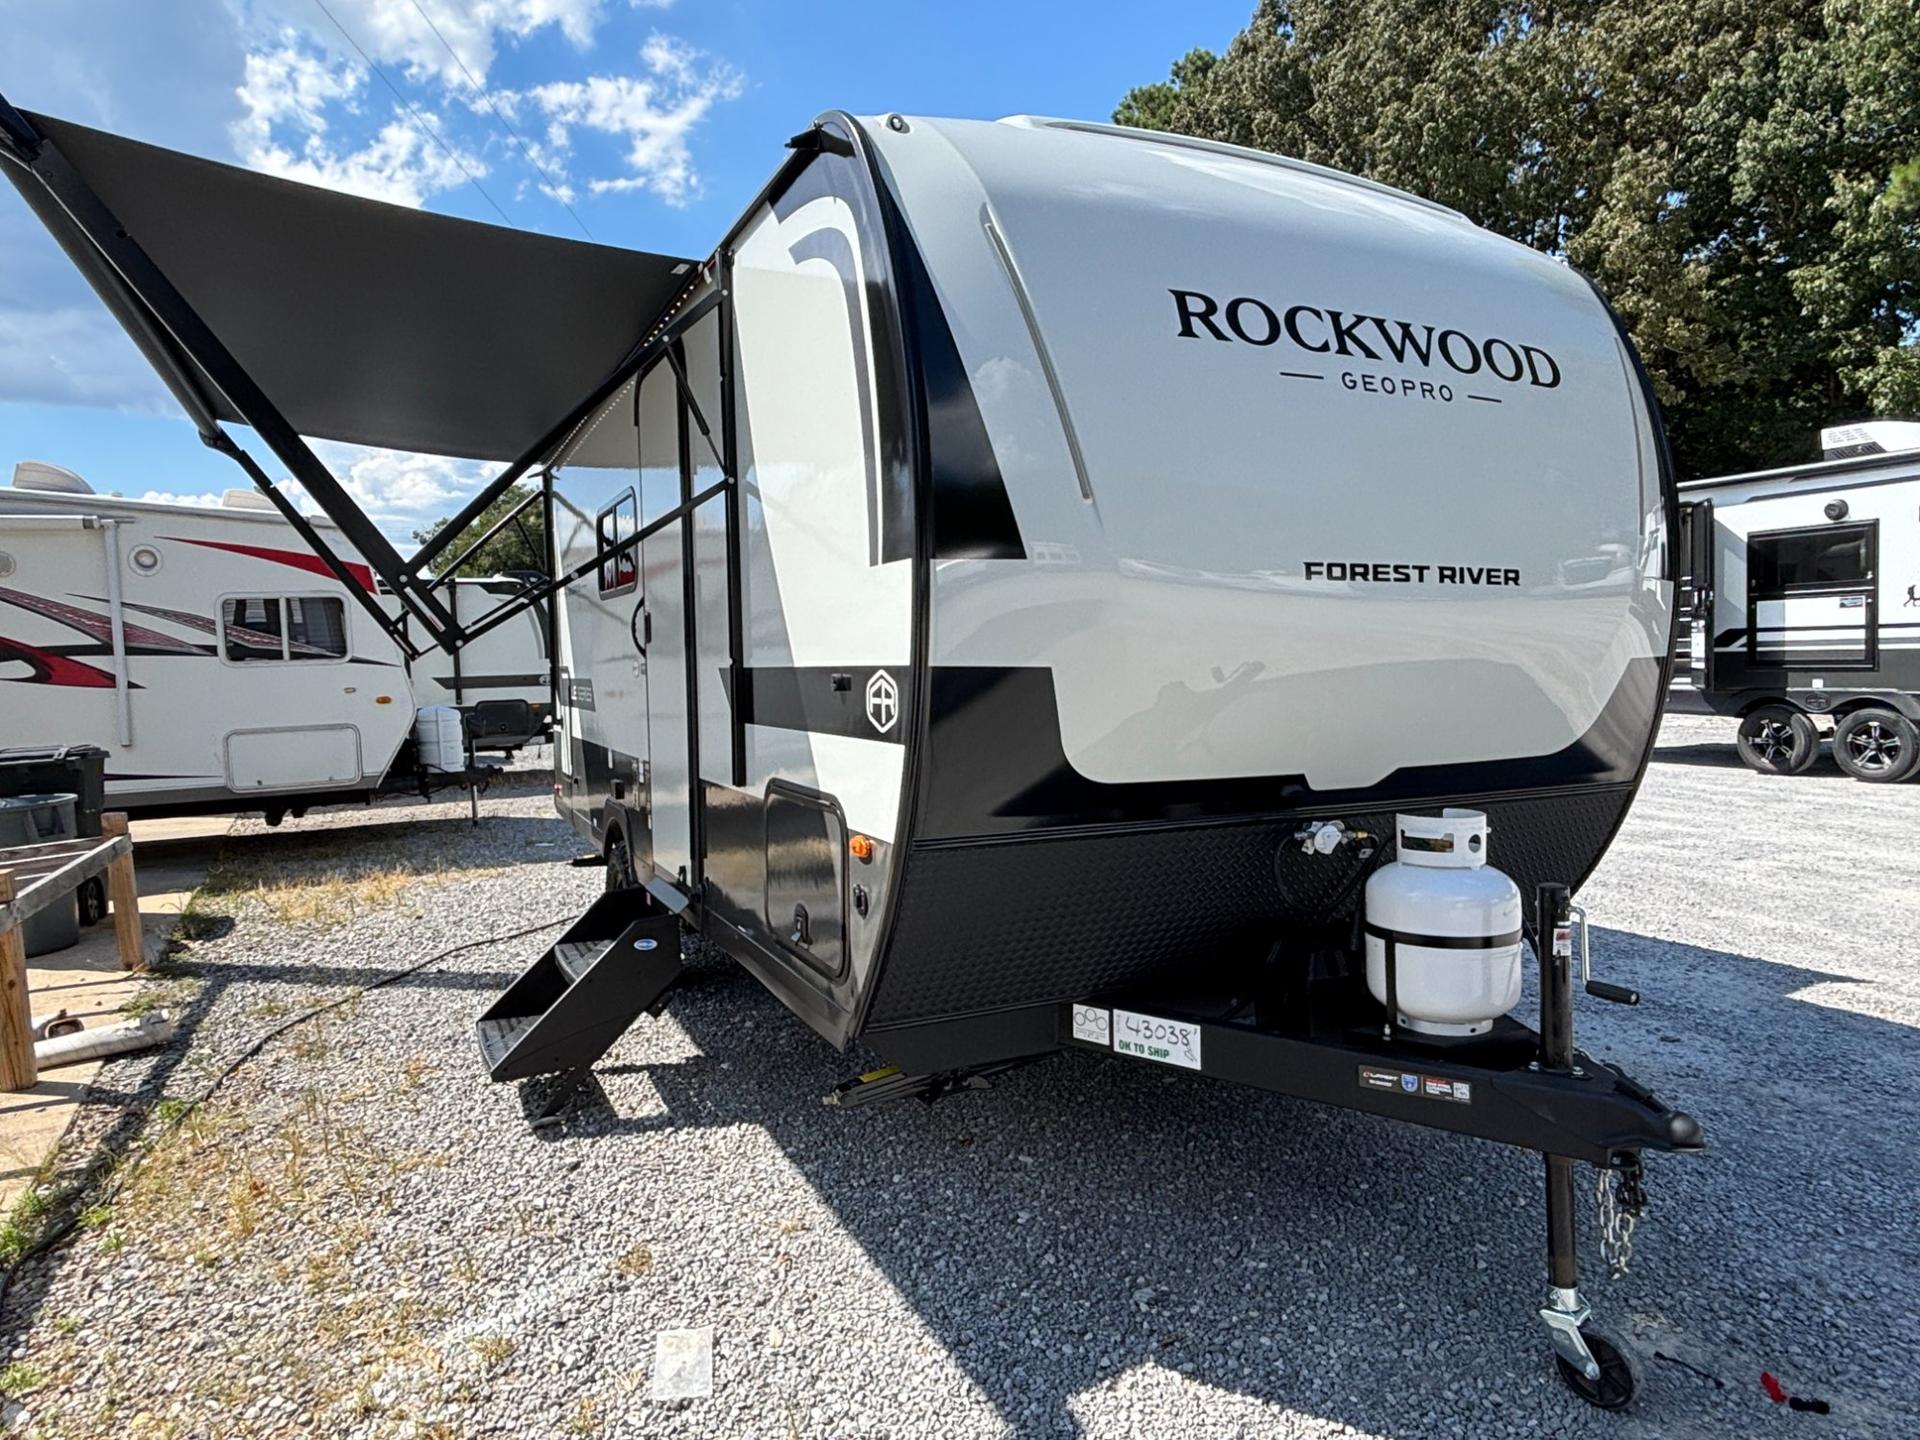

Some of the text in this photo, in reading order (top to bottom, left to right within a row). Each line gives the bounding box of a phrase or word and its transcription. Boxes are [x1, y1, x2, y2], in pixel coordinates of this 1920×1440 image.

[1168, 289, 1561, 389] ROCKWOOD
[1341, 372, 1454, 402] GEOPRO
[1303, 562, 1520, 586] FOREST RIVER
[1118, 1040, 1170, 1059] OK TO SHIP
